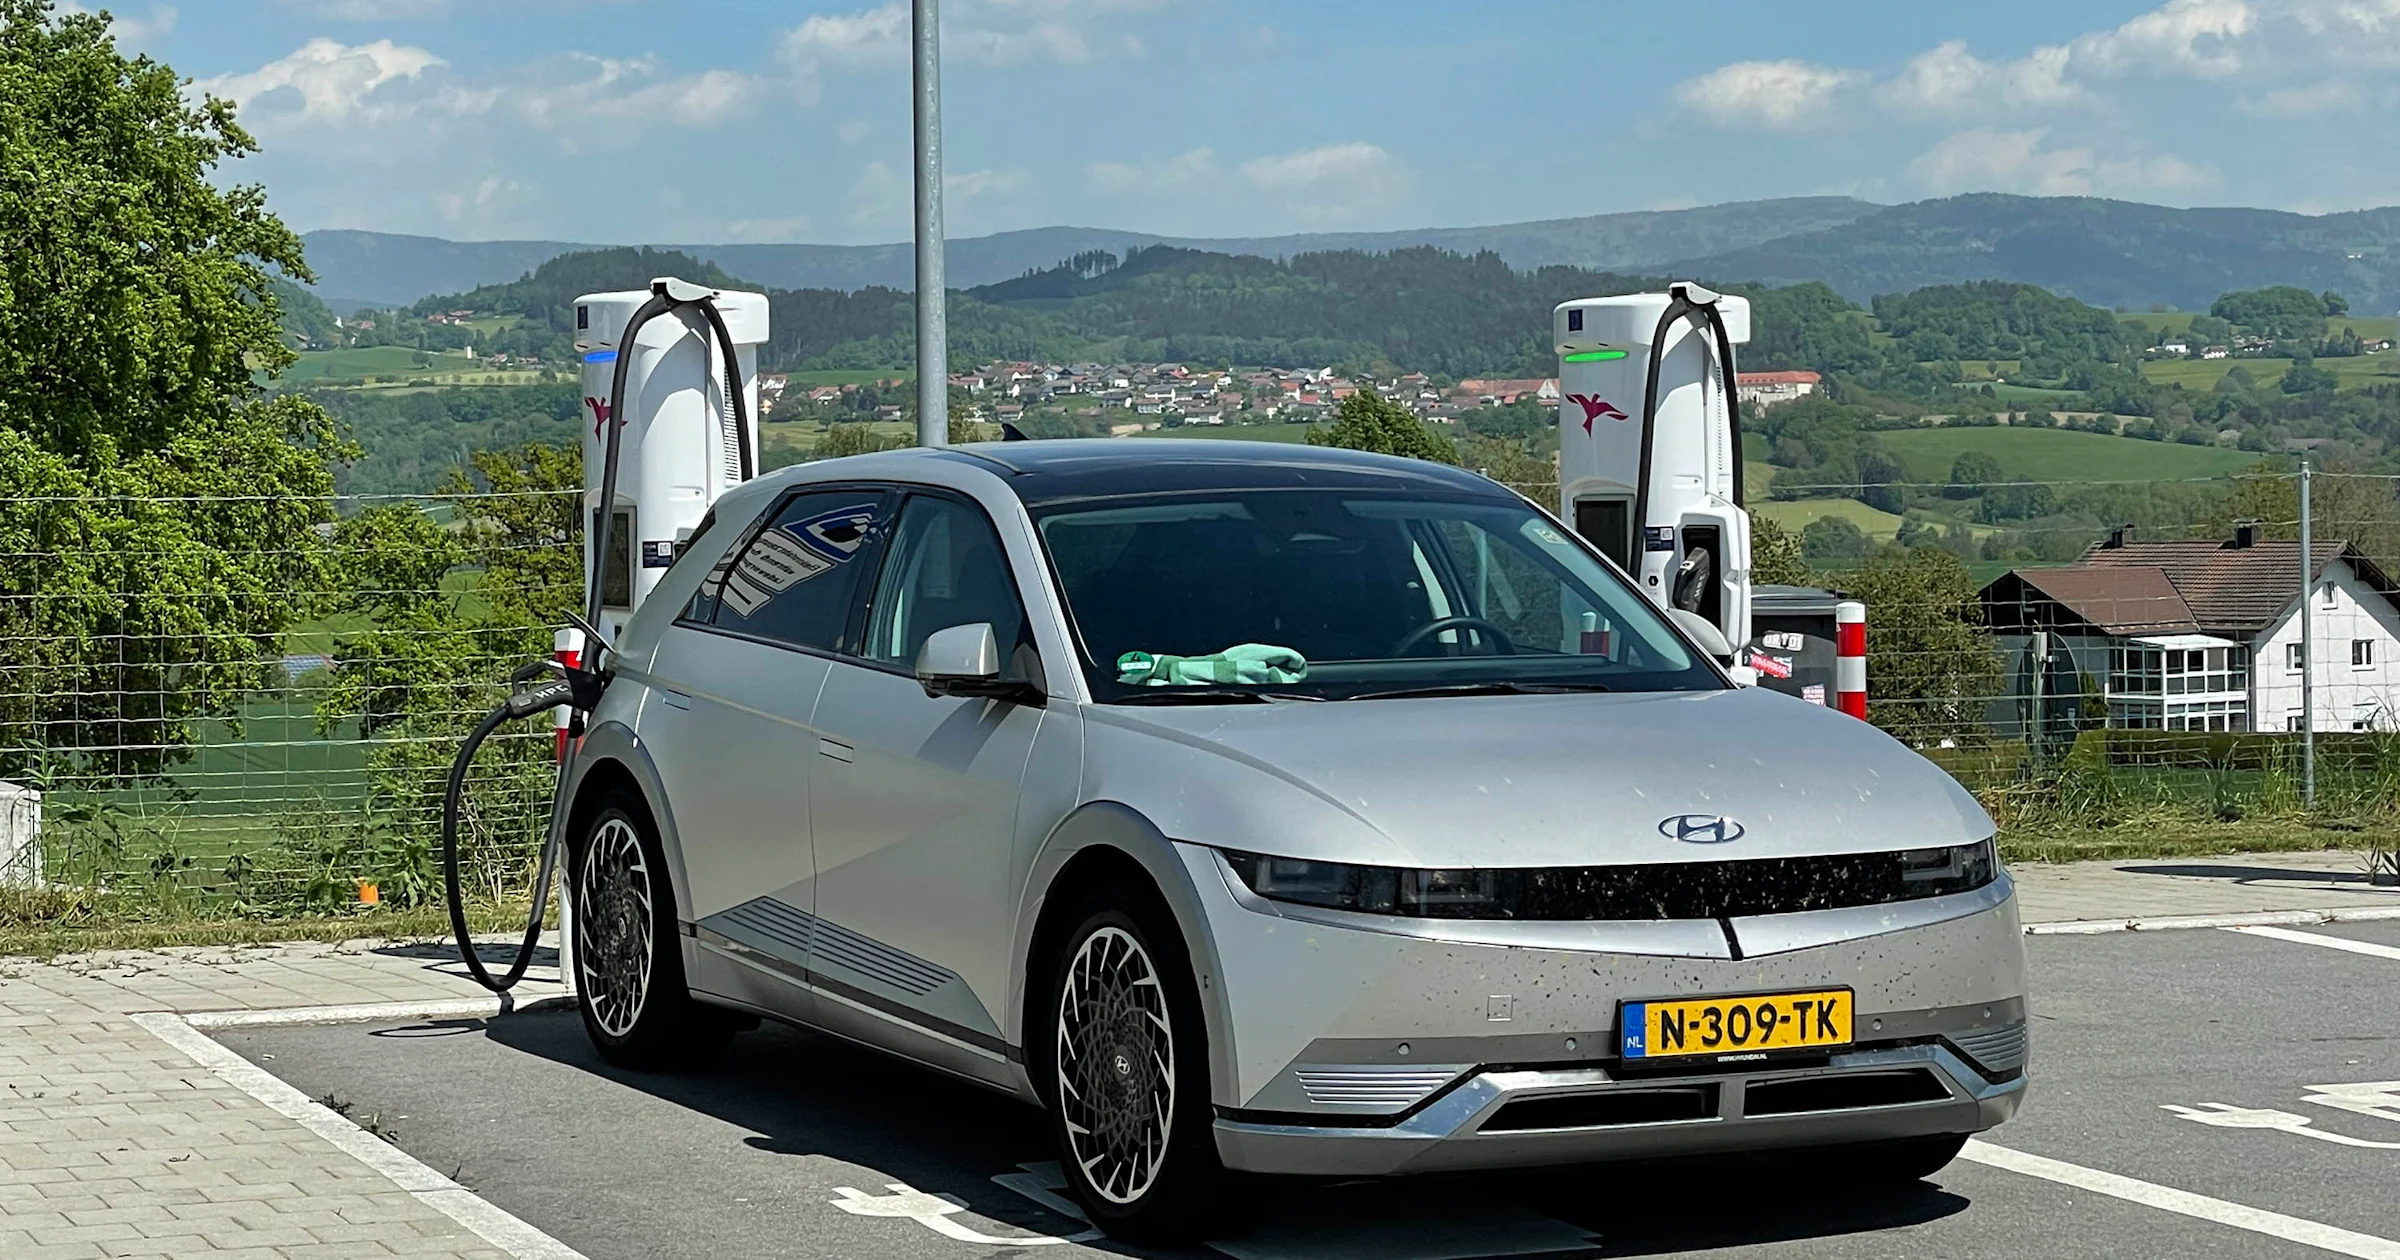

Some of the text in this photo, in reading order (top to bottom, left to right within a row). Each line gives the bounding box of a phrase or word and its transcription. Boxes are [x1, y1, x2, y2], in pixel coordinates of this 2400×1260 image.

[534, 684, 569, 699] HPC
[1660, 998, 1839, 1050] N-309-TK
[1627, 1035, 1643, 1048] NL
